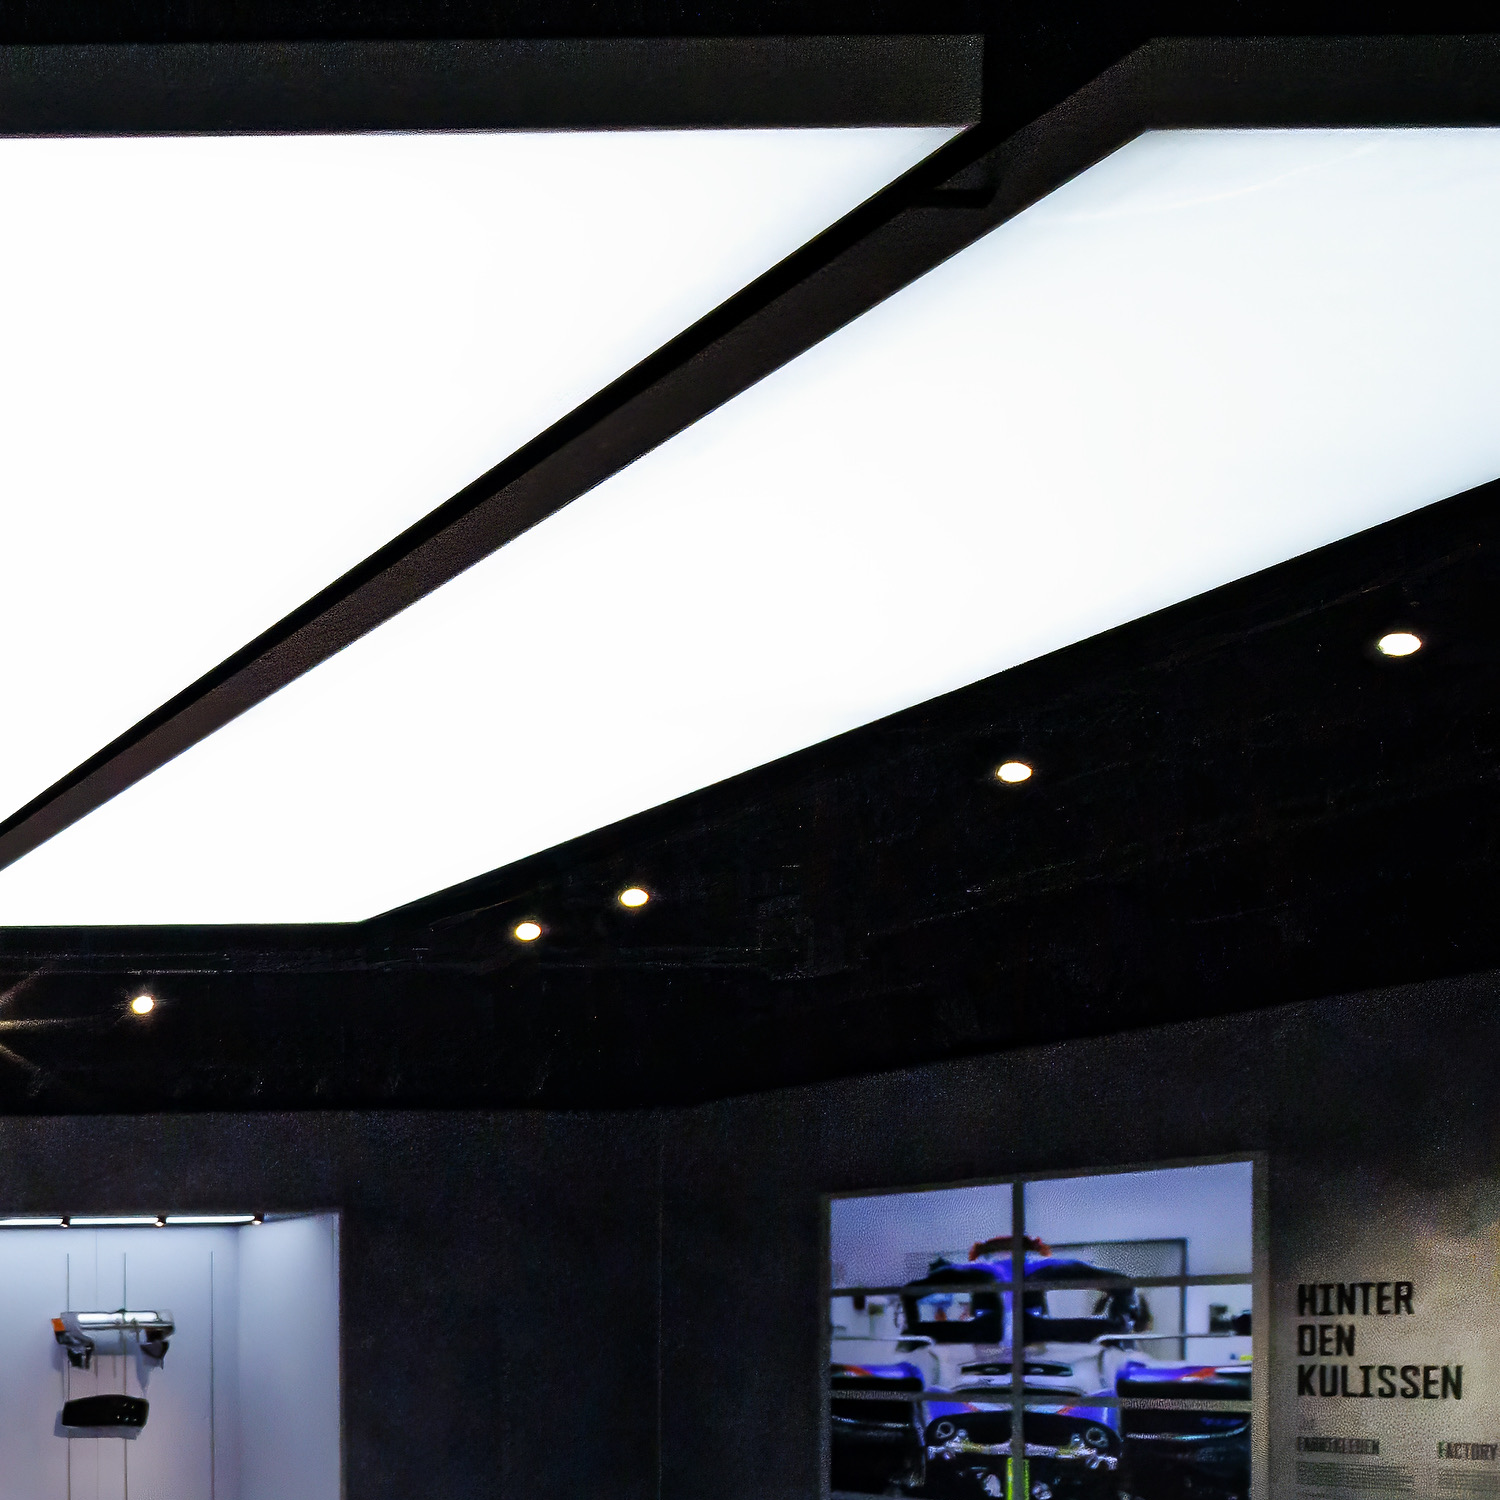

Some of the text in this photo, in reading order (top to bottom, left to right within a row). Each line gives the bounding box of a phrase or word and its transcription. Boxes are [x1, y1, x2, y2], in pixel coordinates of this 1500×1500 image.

[1298, 1281, 1414, 1316] HINTER
[1297, 1324, 1356, 1356] DEN
[1297, 1364, 1464, 1400] KULISSEN
